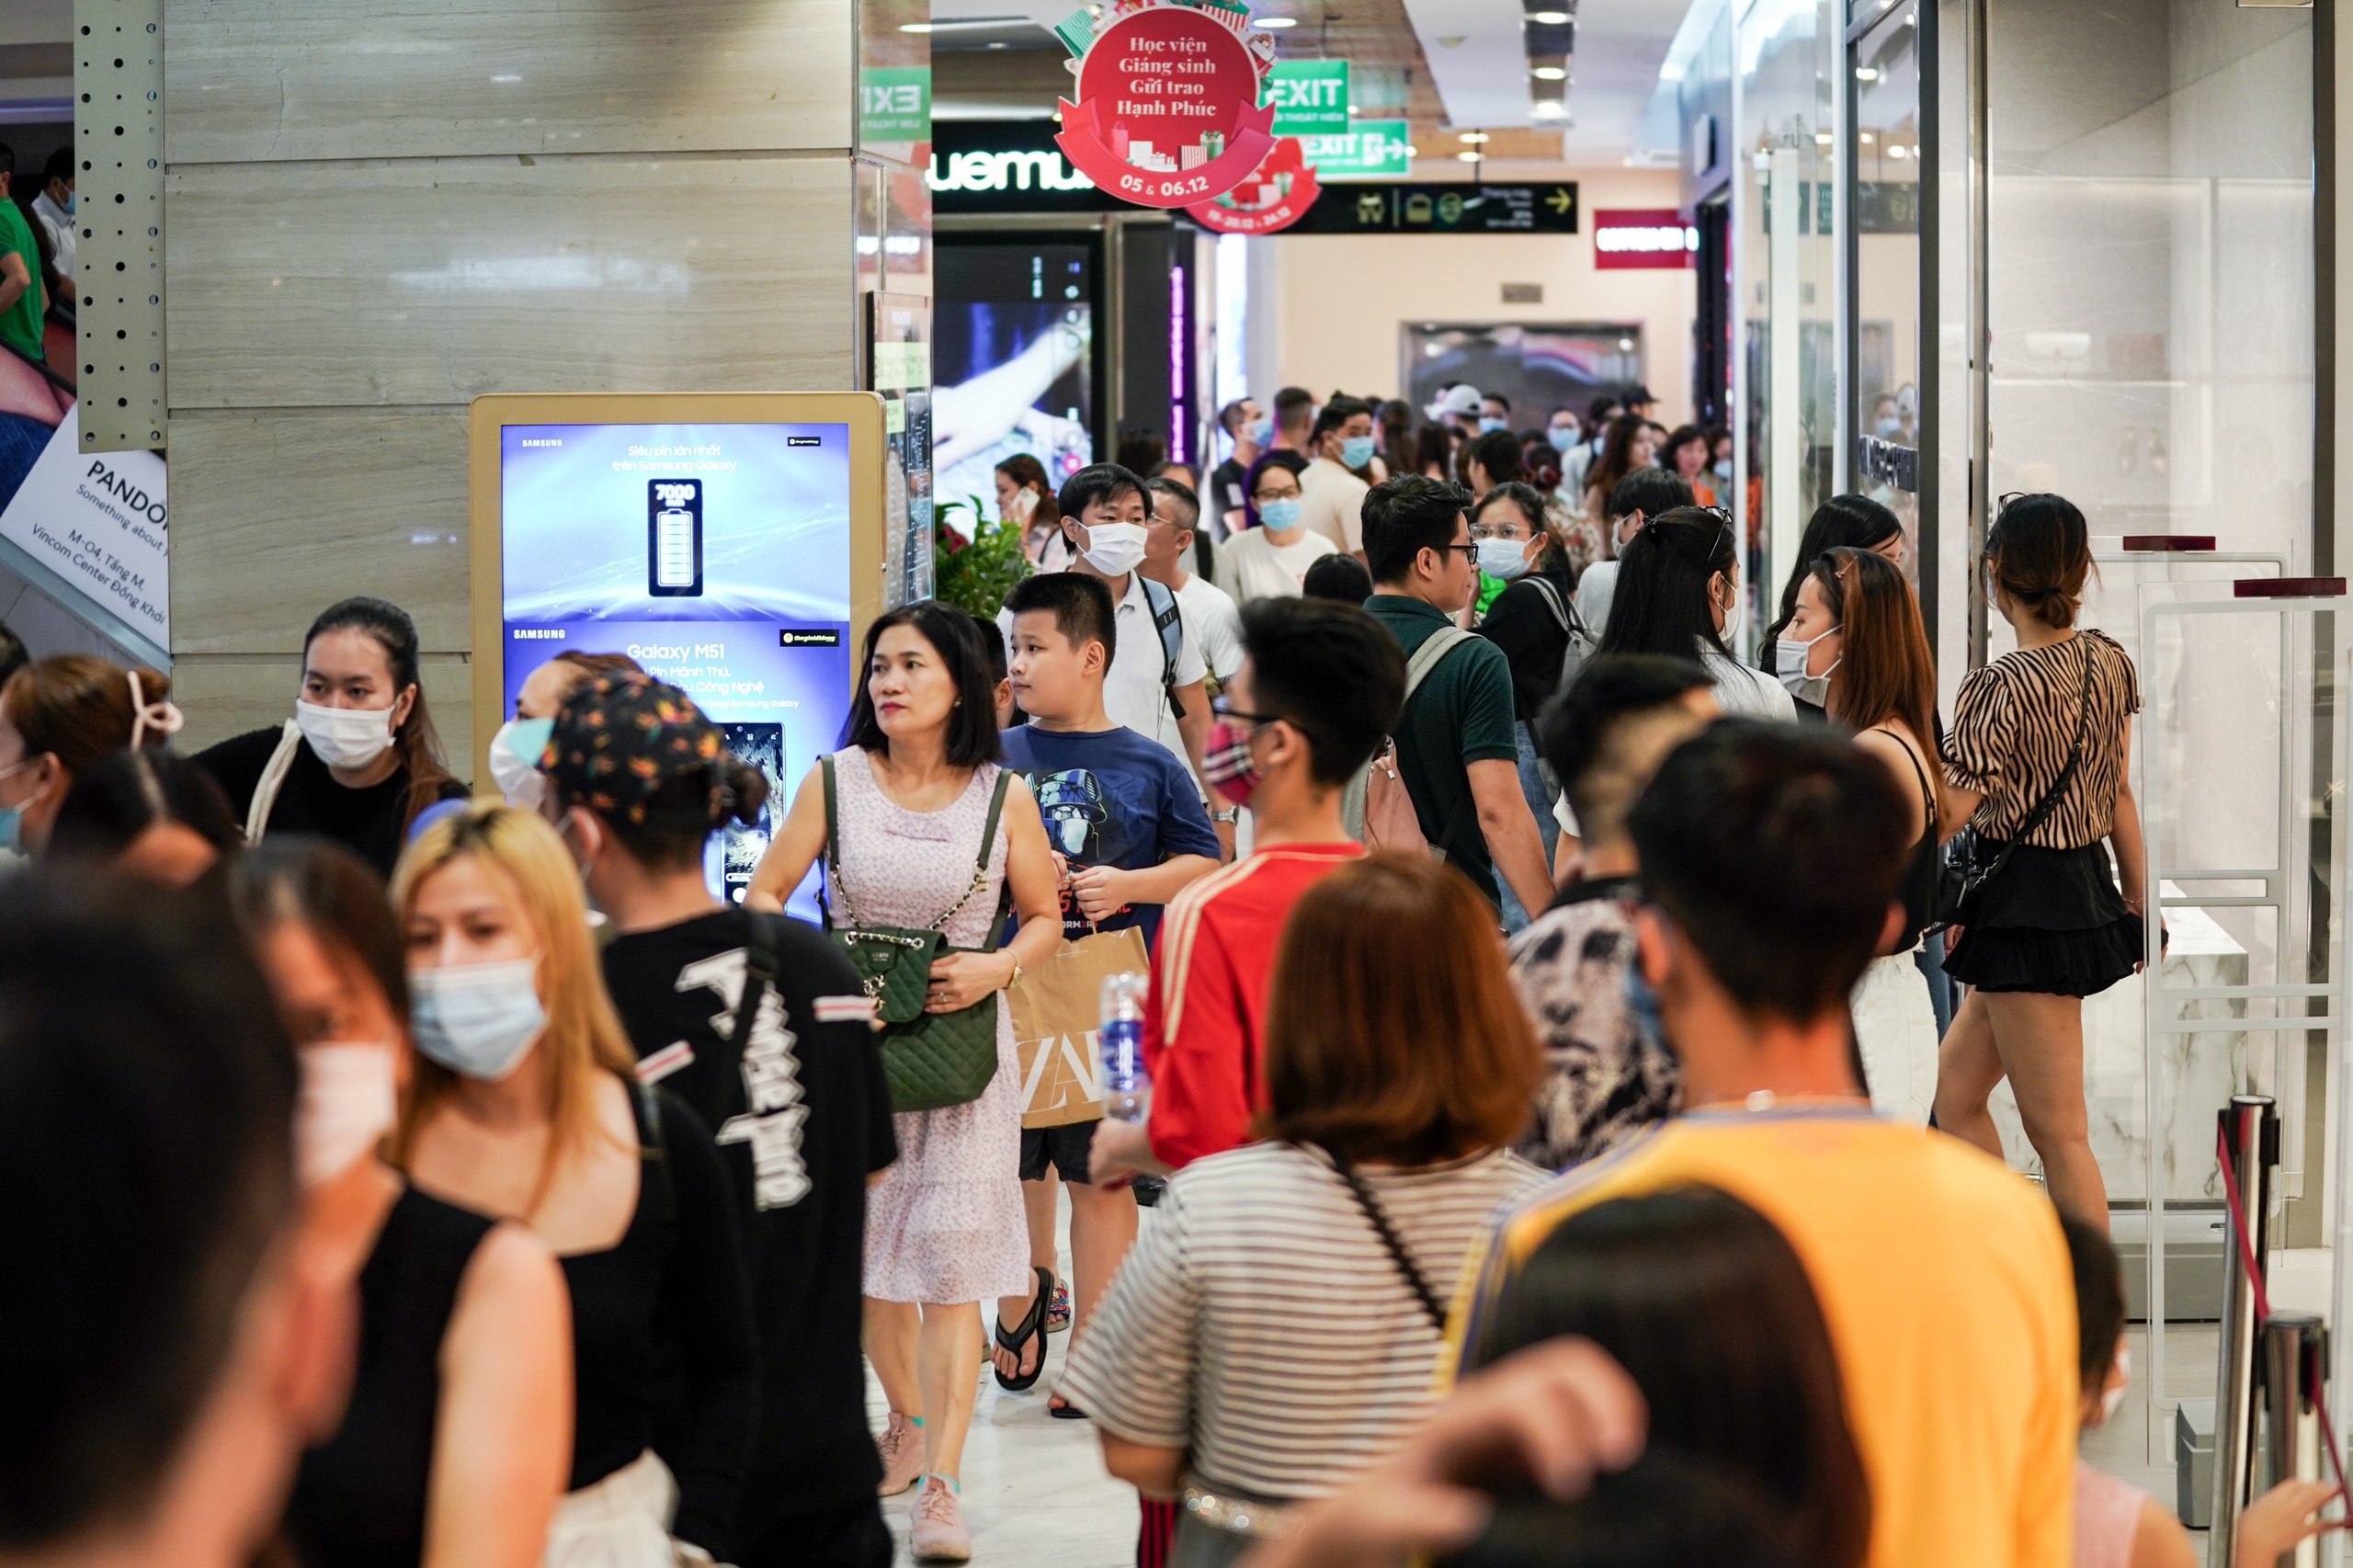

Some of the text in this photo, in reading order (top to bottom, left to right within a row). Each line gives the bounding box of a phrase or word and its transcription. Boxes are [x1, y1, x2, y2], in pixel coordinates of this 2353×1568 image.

[1130, 37, 1207, 55] Học viện
[1119, 57, 1216, 75] Giáng sinh
[1130, 77, 1205, 95] Gửi trao
[1265, 79, 1344, 107] EXIT
[1117, 99, 1217, 118] Hạnh Phúc
[928, 151, 1096, 191] uemu
[1120, 174, 1210, 196] 05 & 06.12
[522, 439, 563, 448] SAMSUNG
[628, 442, 722, 459] Siêu pin lớn nhất
[611, 460, 737, 473] trên Samsung Galaxy
[87, 460, 168, 530] PANDO
[655, 483, 695, 500] 7000
[76, 483, 164, 551] Something about
[32, 522, 72, 559] Vincom
[73, 553, 111, 585] Center
[514, 629, 565, 640] SAMSUNG
[627, 643, 725, 664] Galaxy M51
[650, 666, 667, 677] Pin
[670, 666, 703, 677] Mãnh
[696, 680, 730, 695] Công
[732, 680, 765, 696] Nghệ
[732, 699, 768, 709] Samsung
[770, 699, 799, 709] Galaxy
